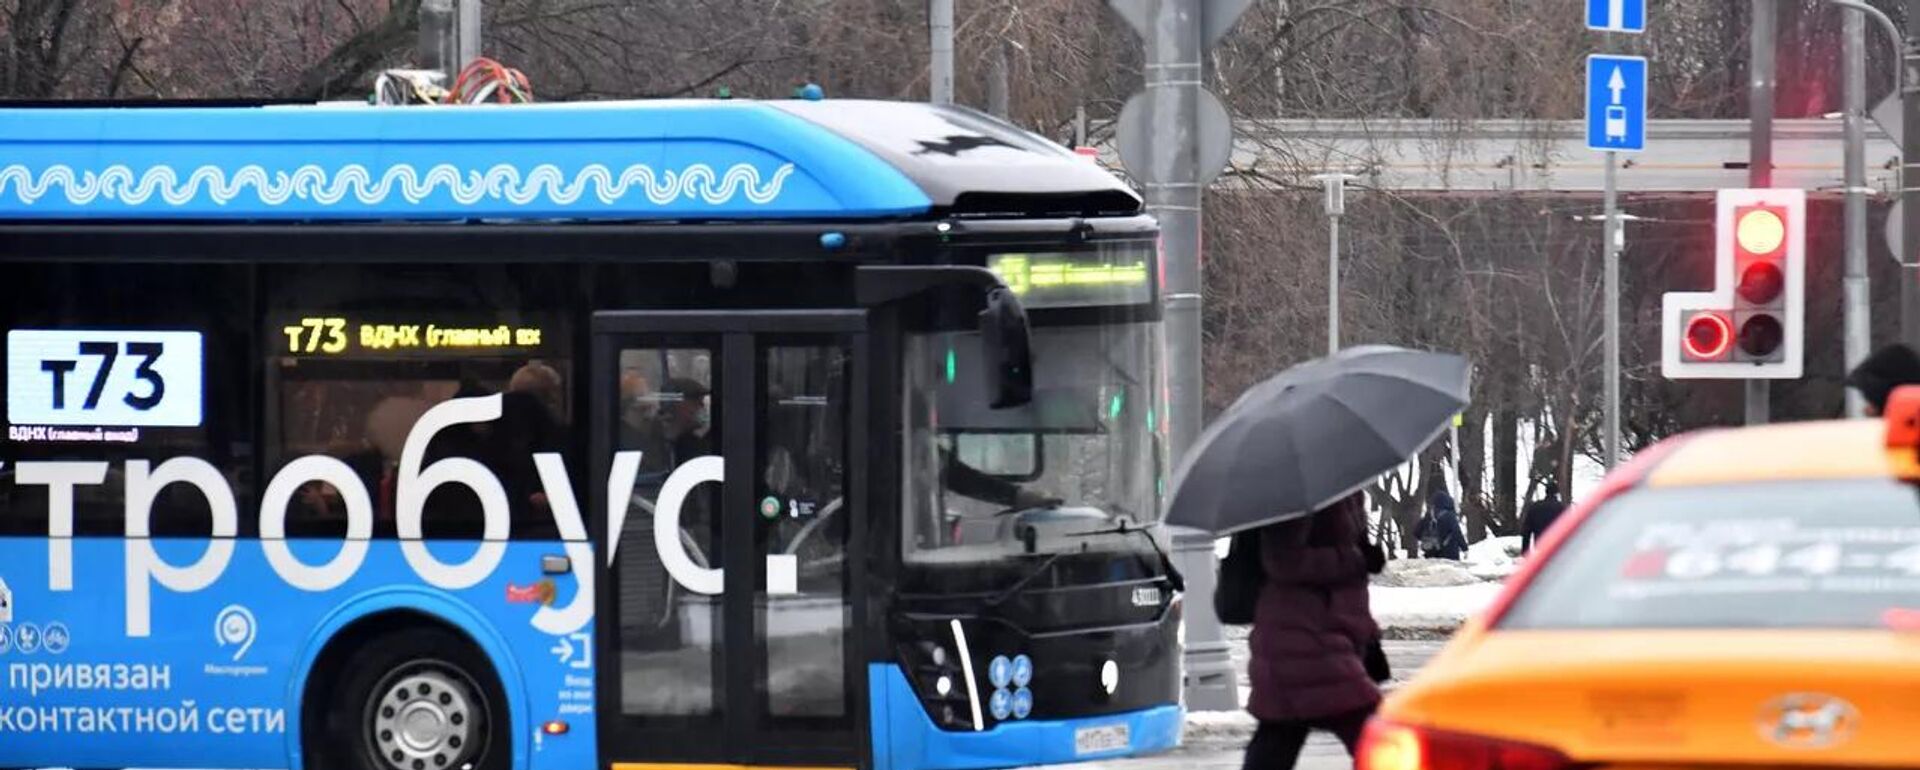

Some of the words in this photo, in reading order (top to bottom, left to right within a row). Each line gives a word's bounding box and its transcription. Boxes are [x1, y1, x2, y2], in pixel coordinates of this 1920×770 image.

[284, 318, 347, 352] т73
[360, 324, 420, 349] ВДНХ
[41, 341, 165, 411] т73
[9, 426, 46, 441] ВДНХ
[9, 663, 171, 697] привязан
[0, 699, 199, 734] контактной
[207, 705, 286, 734] сети
